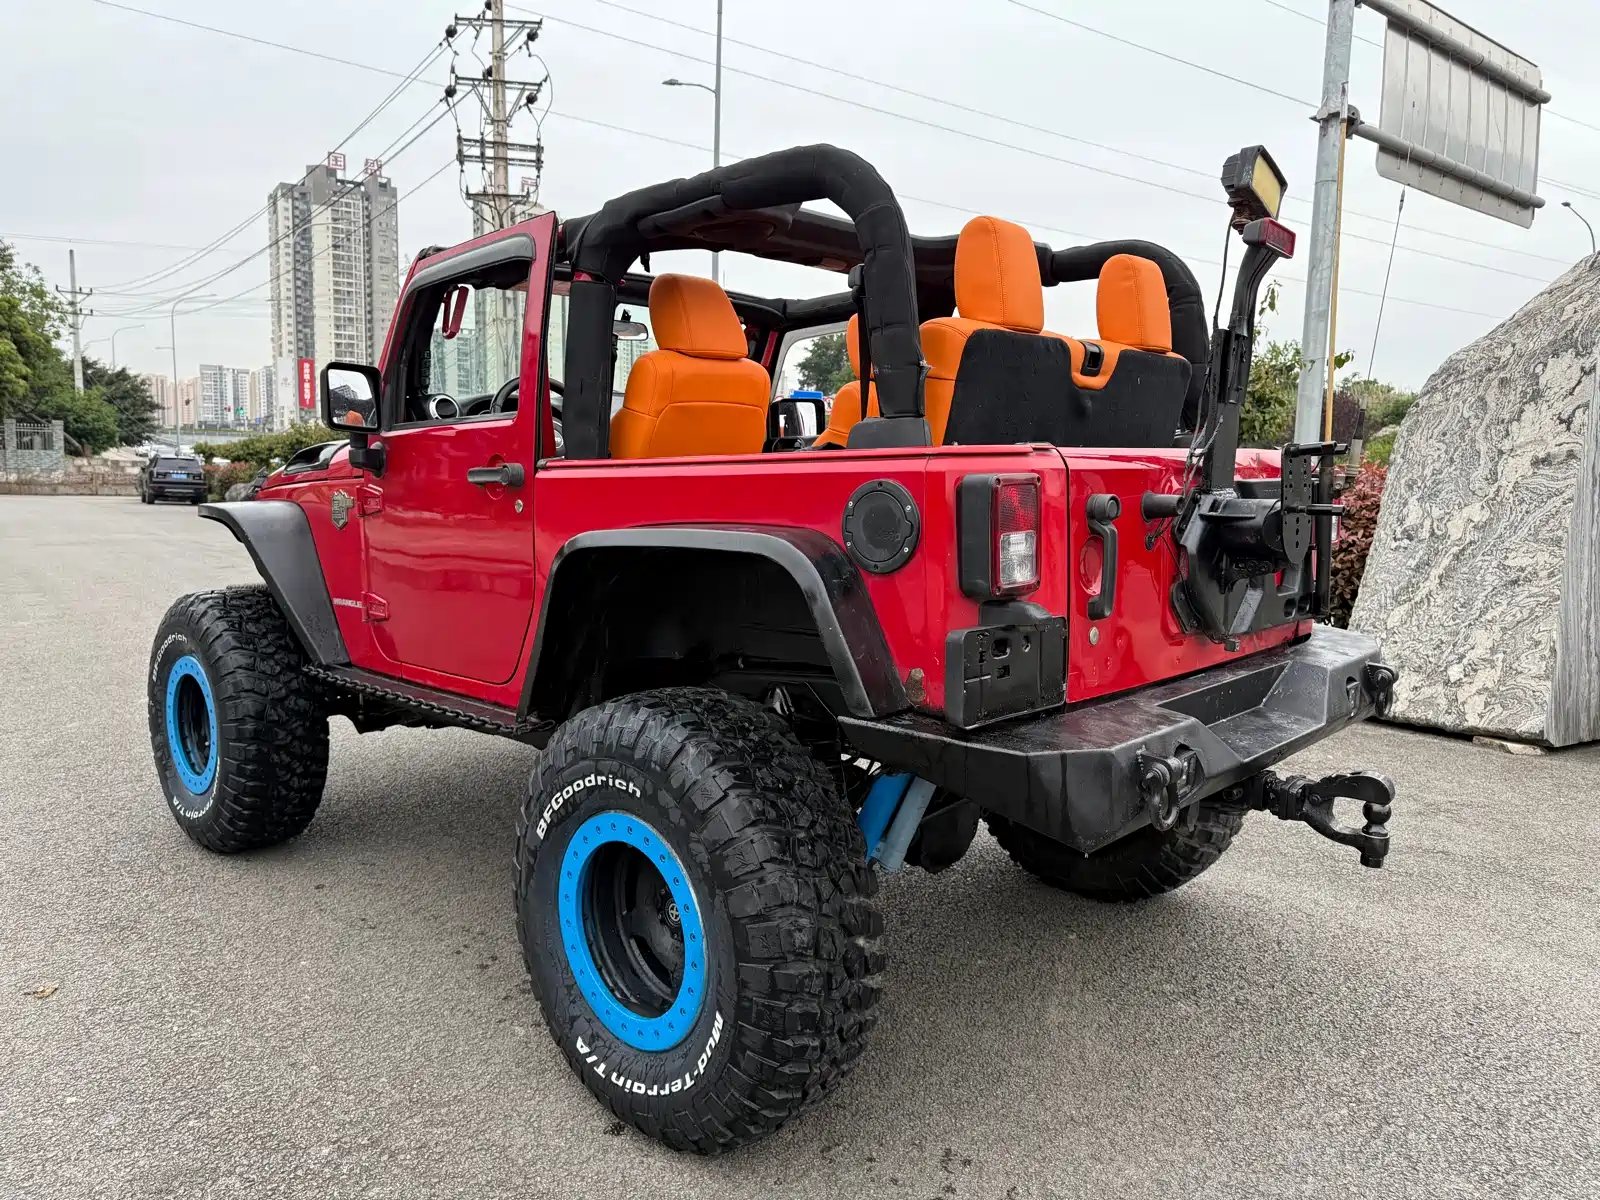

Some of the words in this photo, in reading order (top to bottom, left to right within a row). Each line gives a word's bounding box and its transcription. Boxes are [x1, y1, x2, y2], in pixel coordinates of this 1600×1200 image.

[332, 597, 363, 609] WRANGLE
[152, 632, 188, 683] BFGoodrich
[536, 773, 642, 840] BFGoodrich
[575, 1035, 607, 1079] T/A
[610, 1010, 724, 1096] Mud-Terrain
